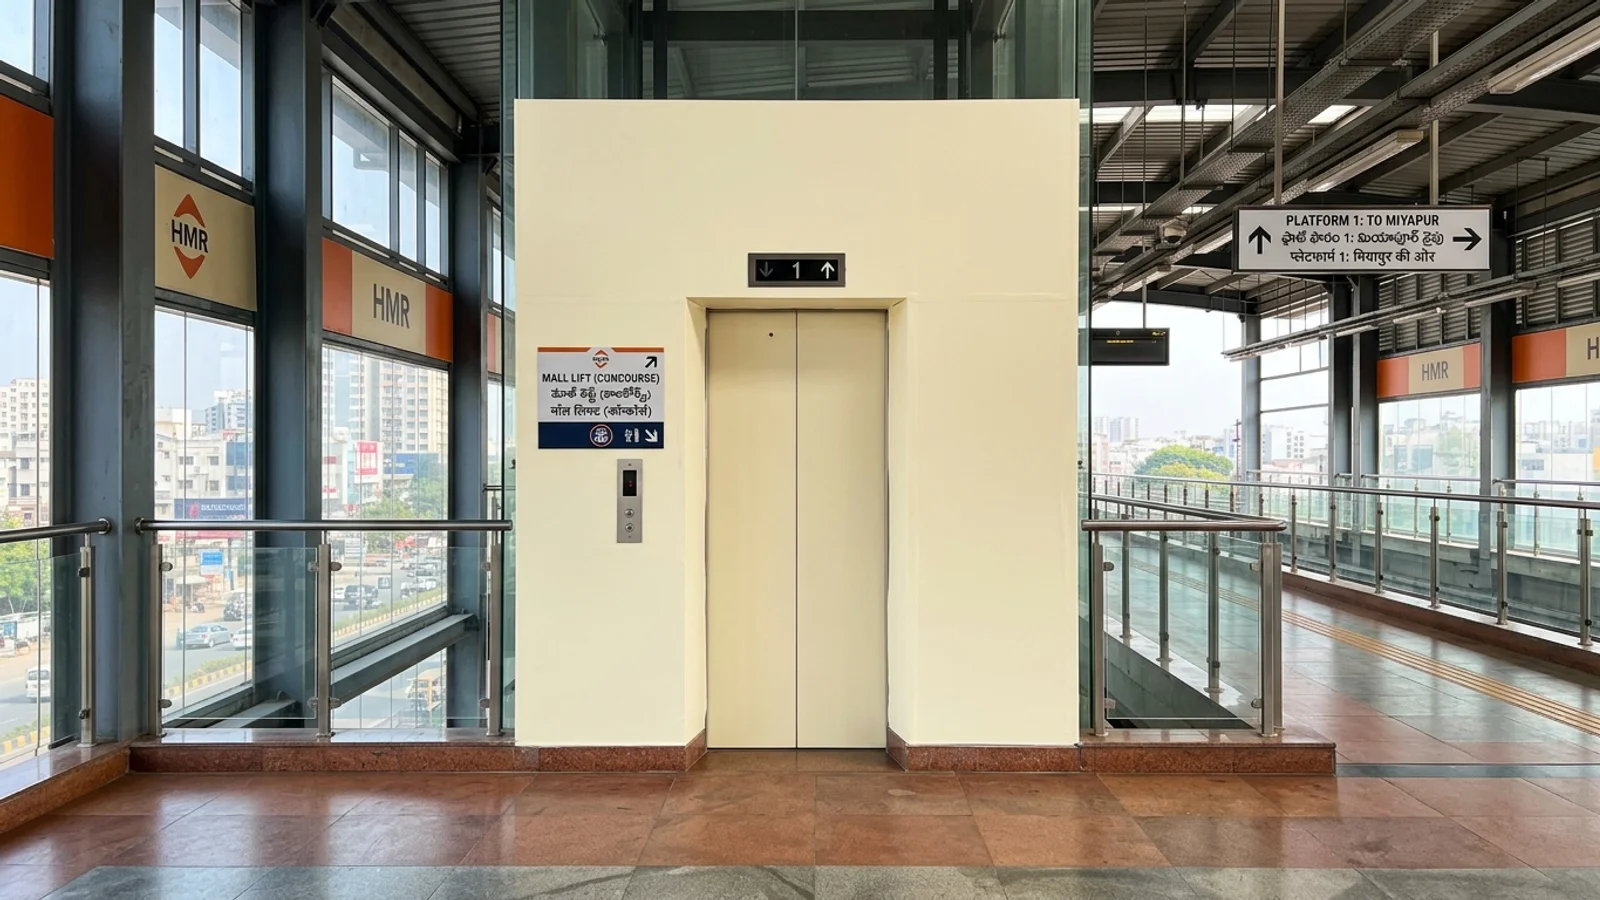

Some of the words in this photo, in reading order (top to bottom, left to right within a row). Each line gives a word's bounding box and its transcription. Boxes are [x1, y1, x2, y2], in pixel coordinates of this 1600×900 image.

[1286, 215, 1349, 226] PLATFORM
[1353, 215, 1364, 226] 1:
[1366, 215, 1382, 226] TO
[1386, 215, 1439, 226] MIYAPUR
[171, 219, 208, 253] HMR
[1344, 232, 1354, 243] 1:
[1339, 251, 1349, 262] 1:
[1395, 248, 1410, 262] की
[1414, 248, 1436, 262] ओर
[792, 261, 800, 279] 1
[373, 283, 410, 329] HMR
[542, 373, 569, 383] MALL
[571, 373, 591, 383] LIFT
[1421, 361, 1449, 381] HMR
